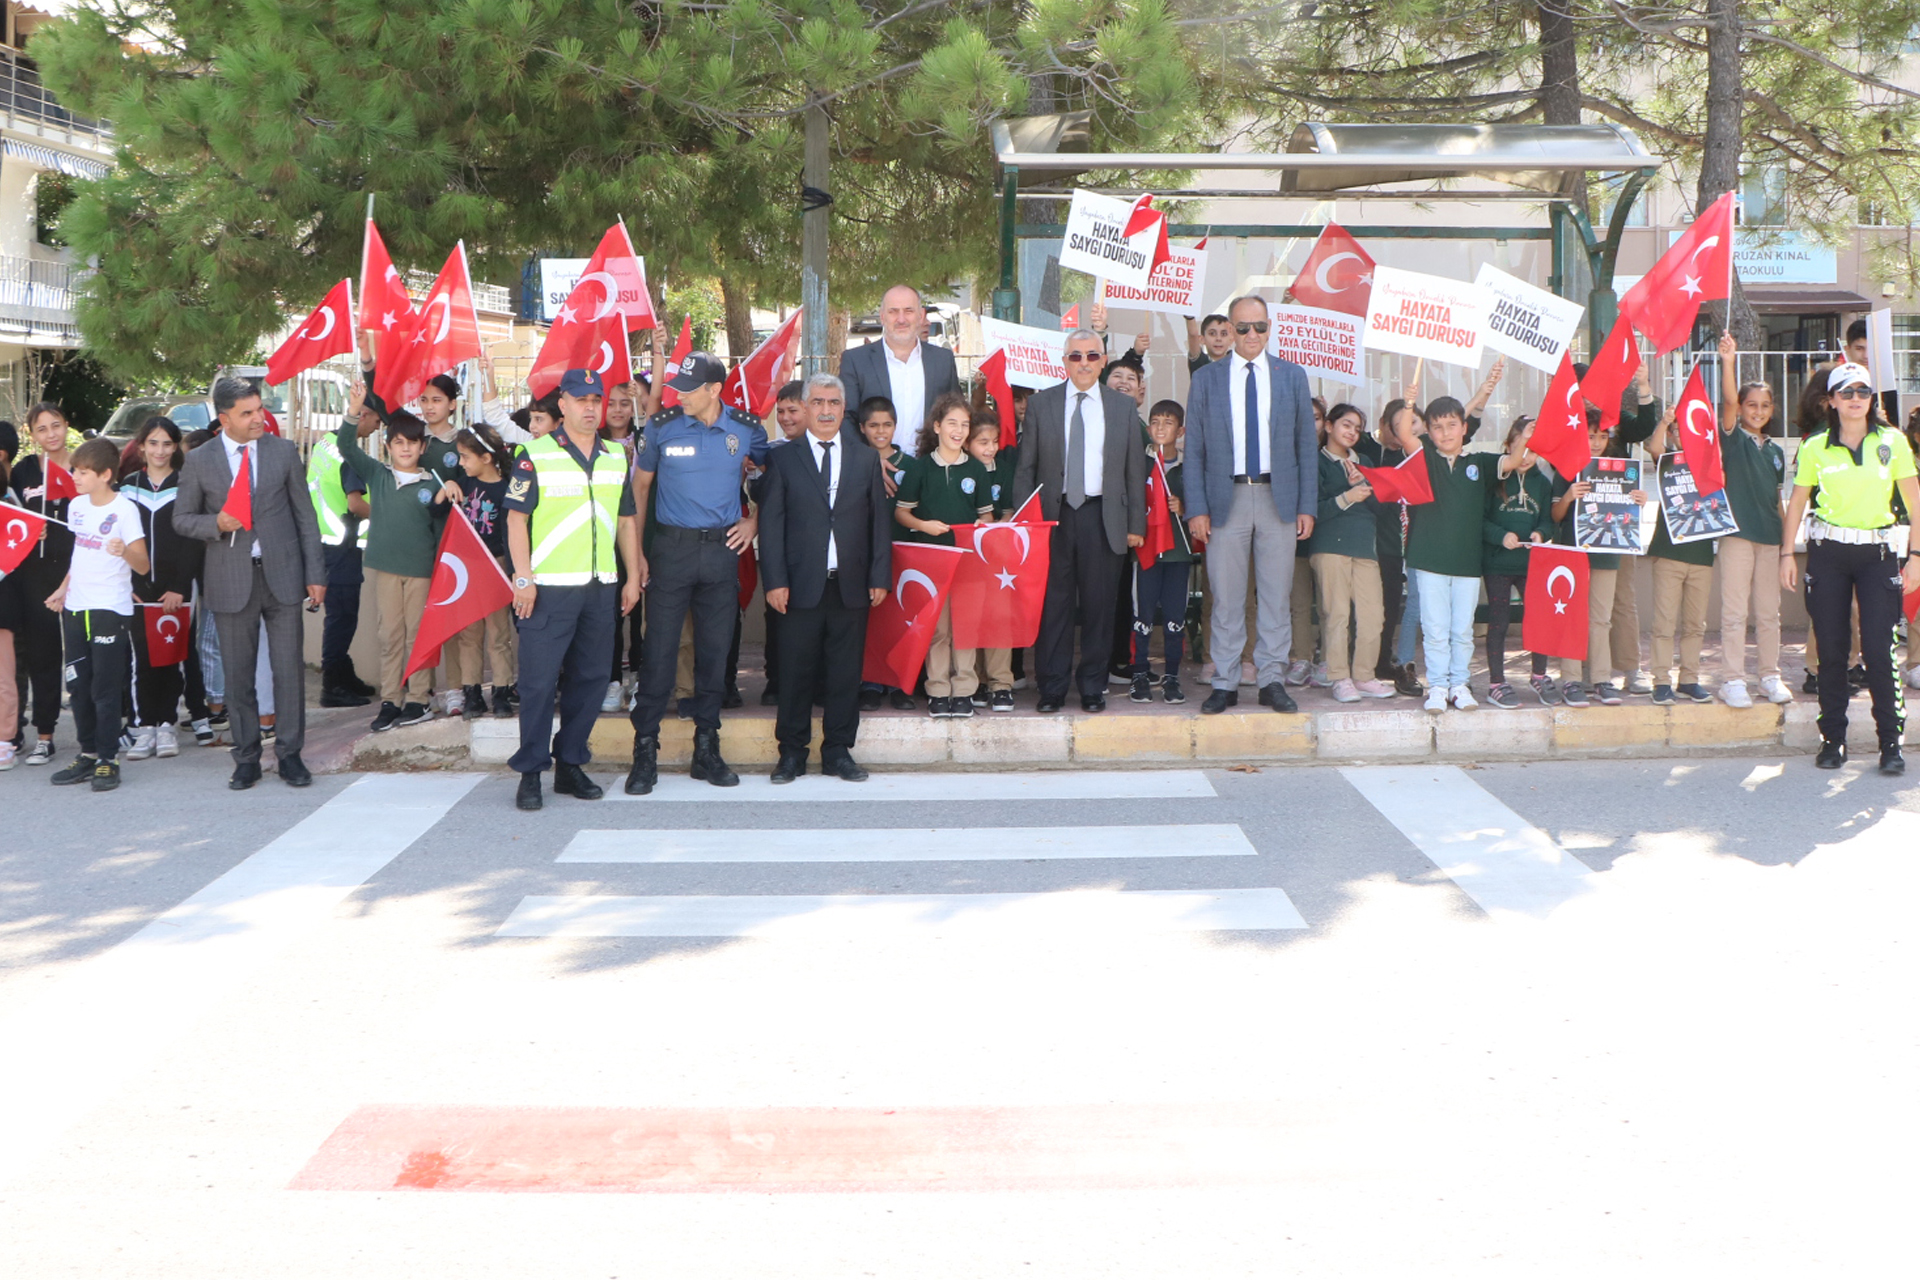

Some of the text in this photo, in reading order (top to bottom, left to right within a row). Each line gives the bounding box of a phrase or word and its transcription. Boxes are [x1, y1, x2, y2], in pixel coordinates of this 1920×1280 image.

[1069, 232, 1147, 270] SAYGI DURUŞU
[1776, 251, 1811, 261] KINAL
[1176, 267, 1194, 279] DE
[1399, 299, 1450, 325] HAYATA
[1495, 298, 1540, 331] HAYATA
[1310, 315, 1355, 333] BAYRAKLARLA
[1372, 313, 1476, 348] SAYGI DURUŞU
[1278, 325, 1294, 335] 29
[1340, 334, 1356, 346] DE
[1278, 336, 1299, 348] YAYA
[1505, 321, 1560, 355] DURUŞU
[1008, 343, 1050, 363] HAYATA
[1583, 492, 1604, 503] SAYGI
[1595, 483, 1622, 494] HAYATA
[1665, 485, 1688, 496] SAYGI
